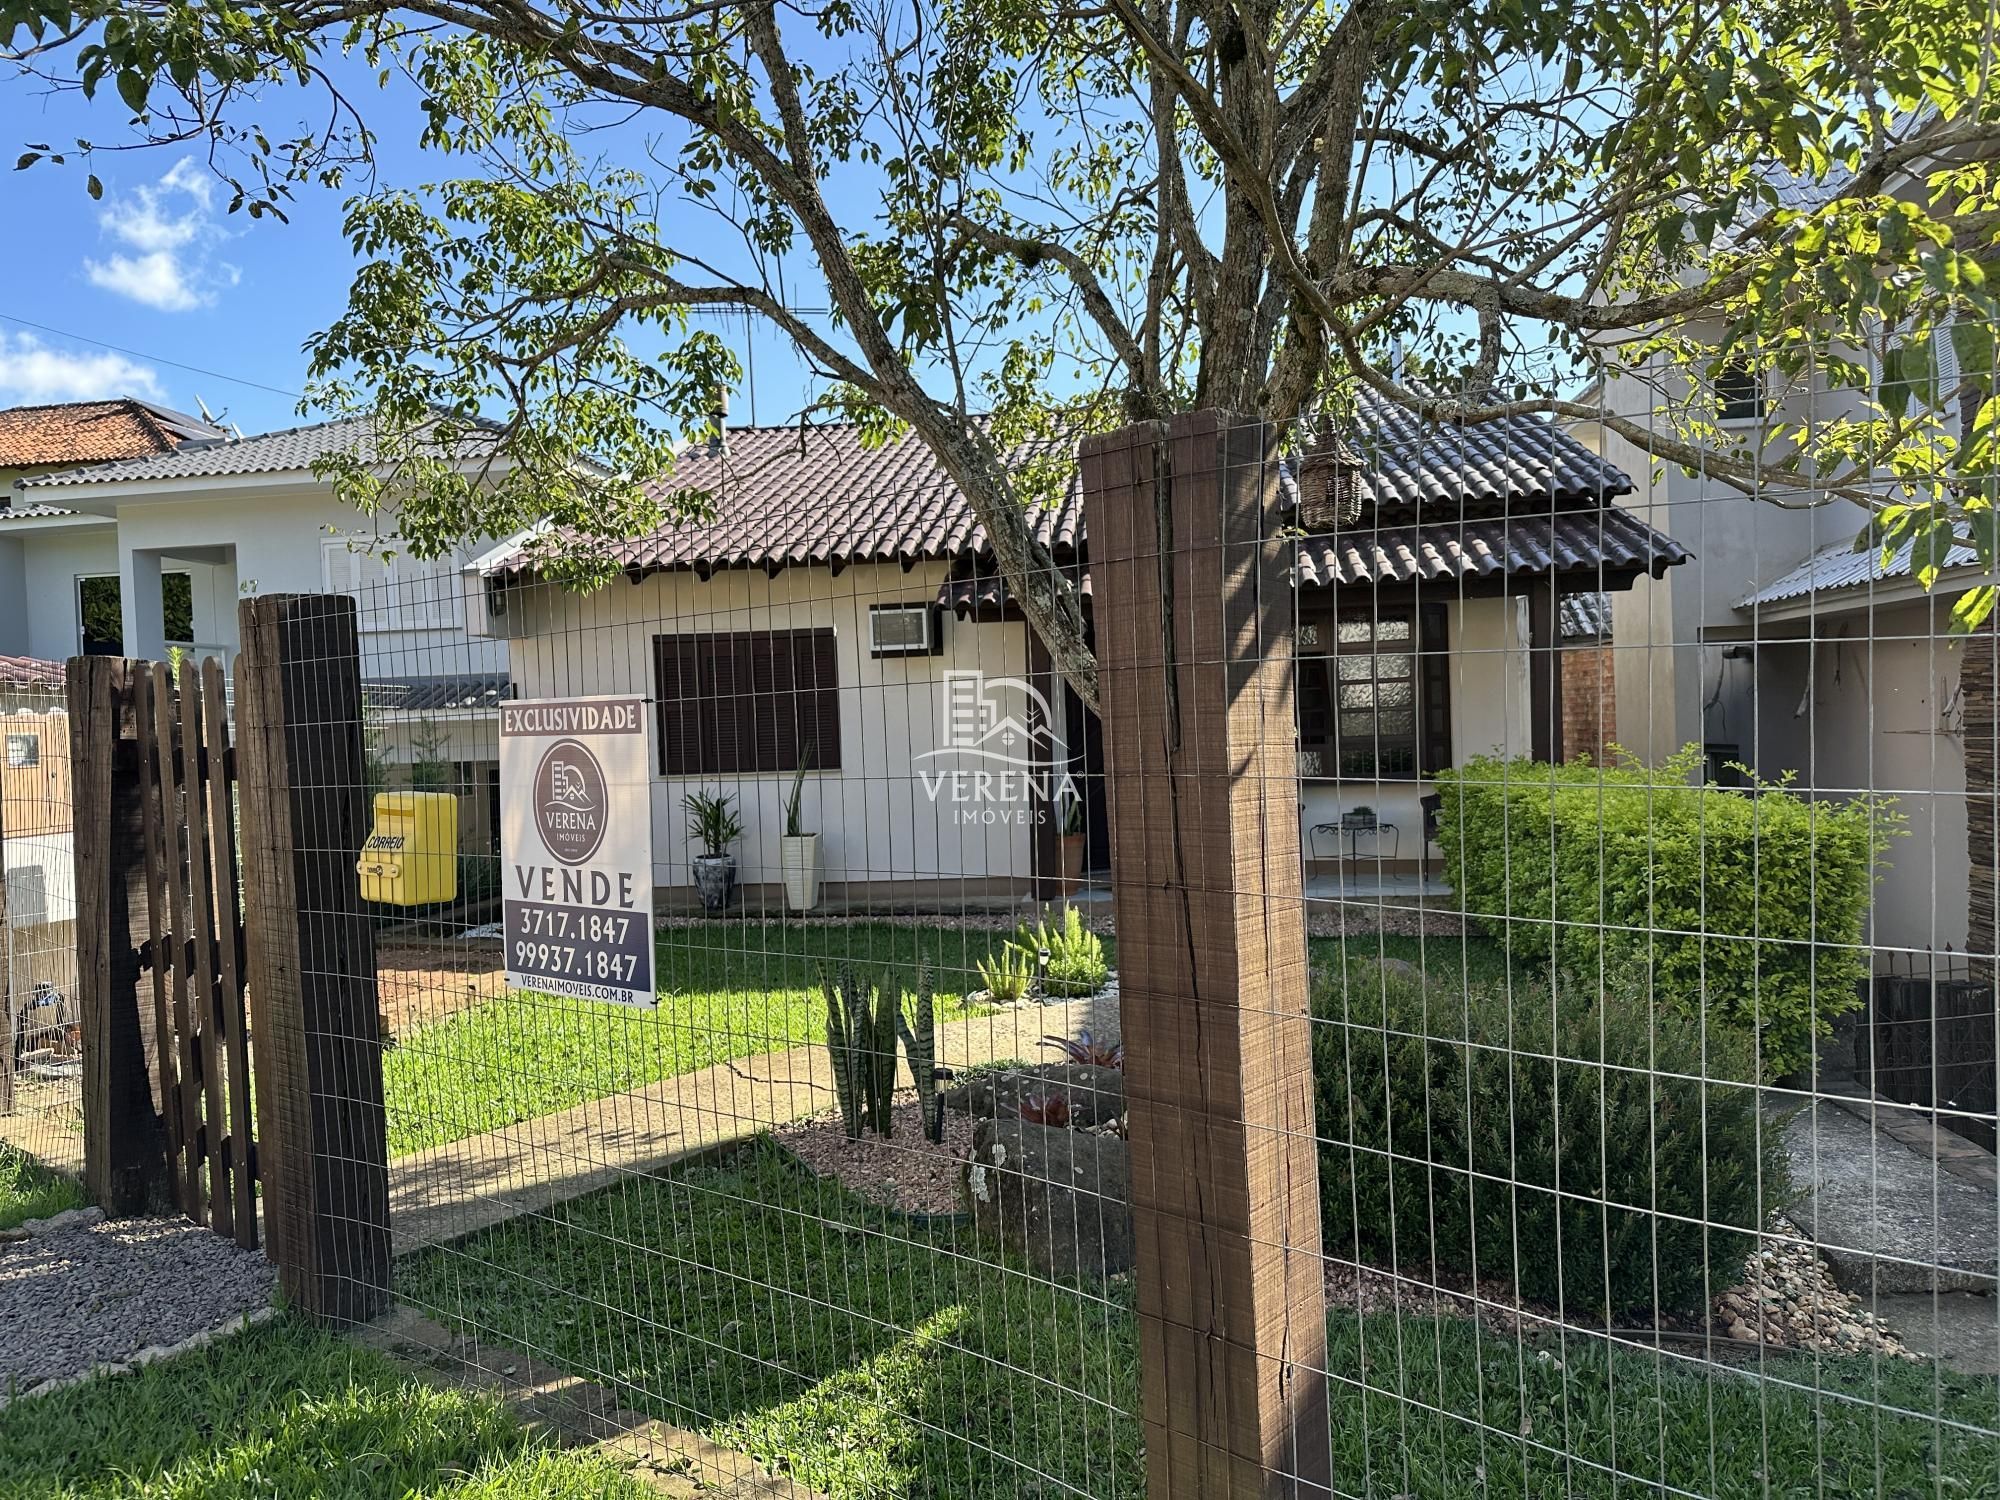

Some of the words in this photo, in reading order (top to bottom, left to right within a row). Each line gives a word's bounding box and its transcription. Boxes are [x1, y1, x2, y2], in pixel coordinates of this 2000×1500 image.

[504, 704, 636, 732] EXCLUSIVIDADE
[546, 812, 596, 831] VERENA
[367, 836, 405, 849] CORREIO
[556, 832, 586, 842] IMÓVEIS
[515, 865, 634, 909] VENDE
[520, 908, 630, 945] 3717.1847
[515, 940, 638, 983] 99937.1847
[521, 974, 634, 1004] VERENAIMOVEIS.COM.BR
